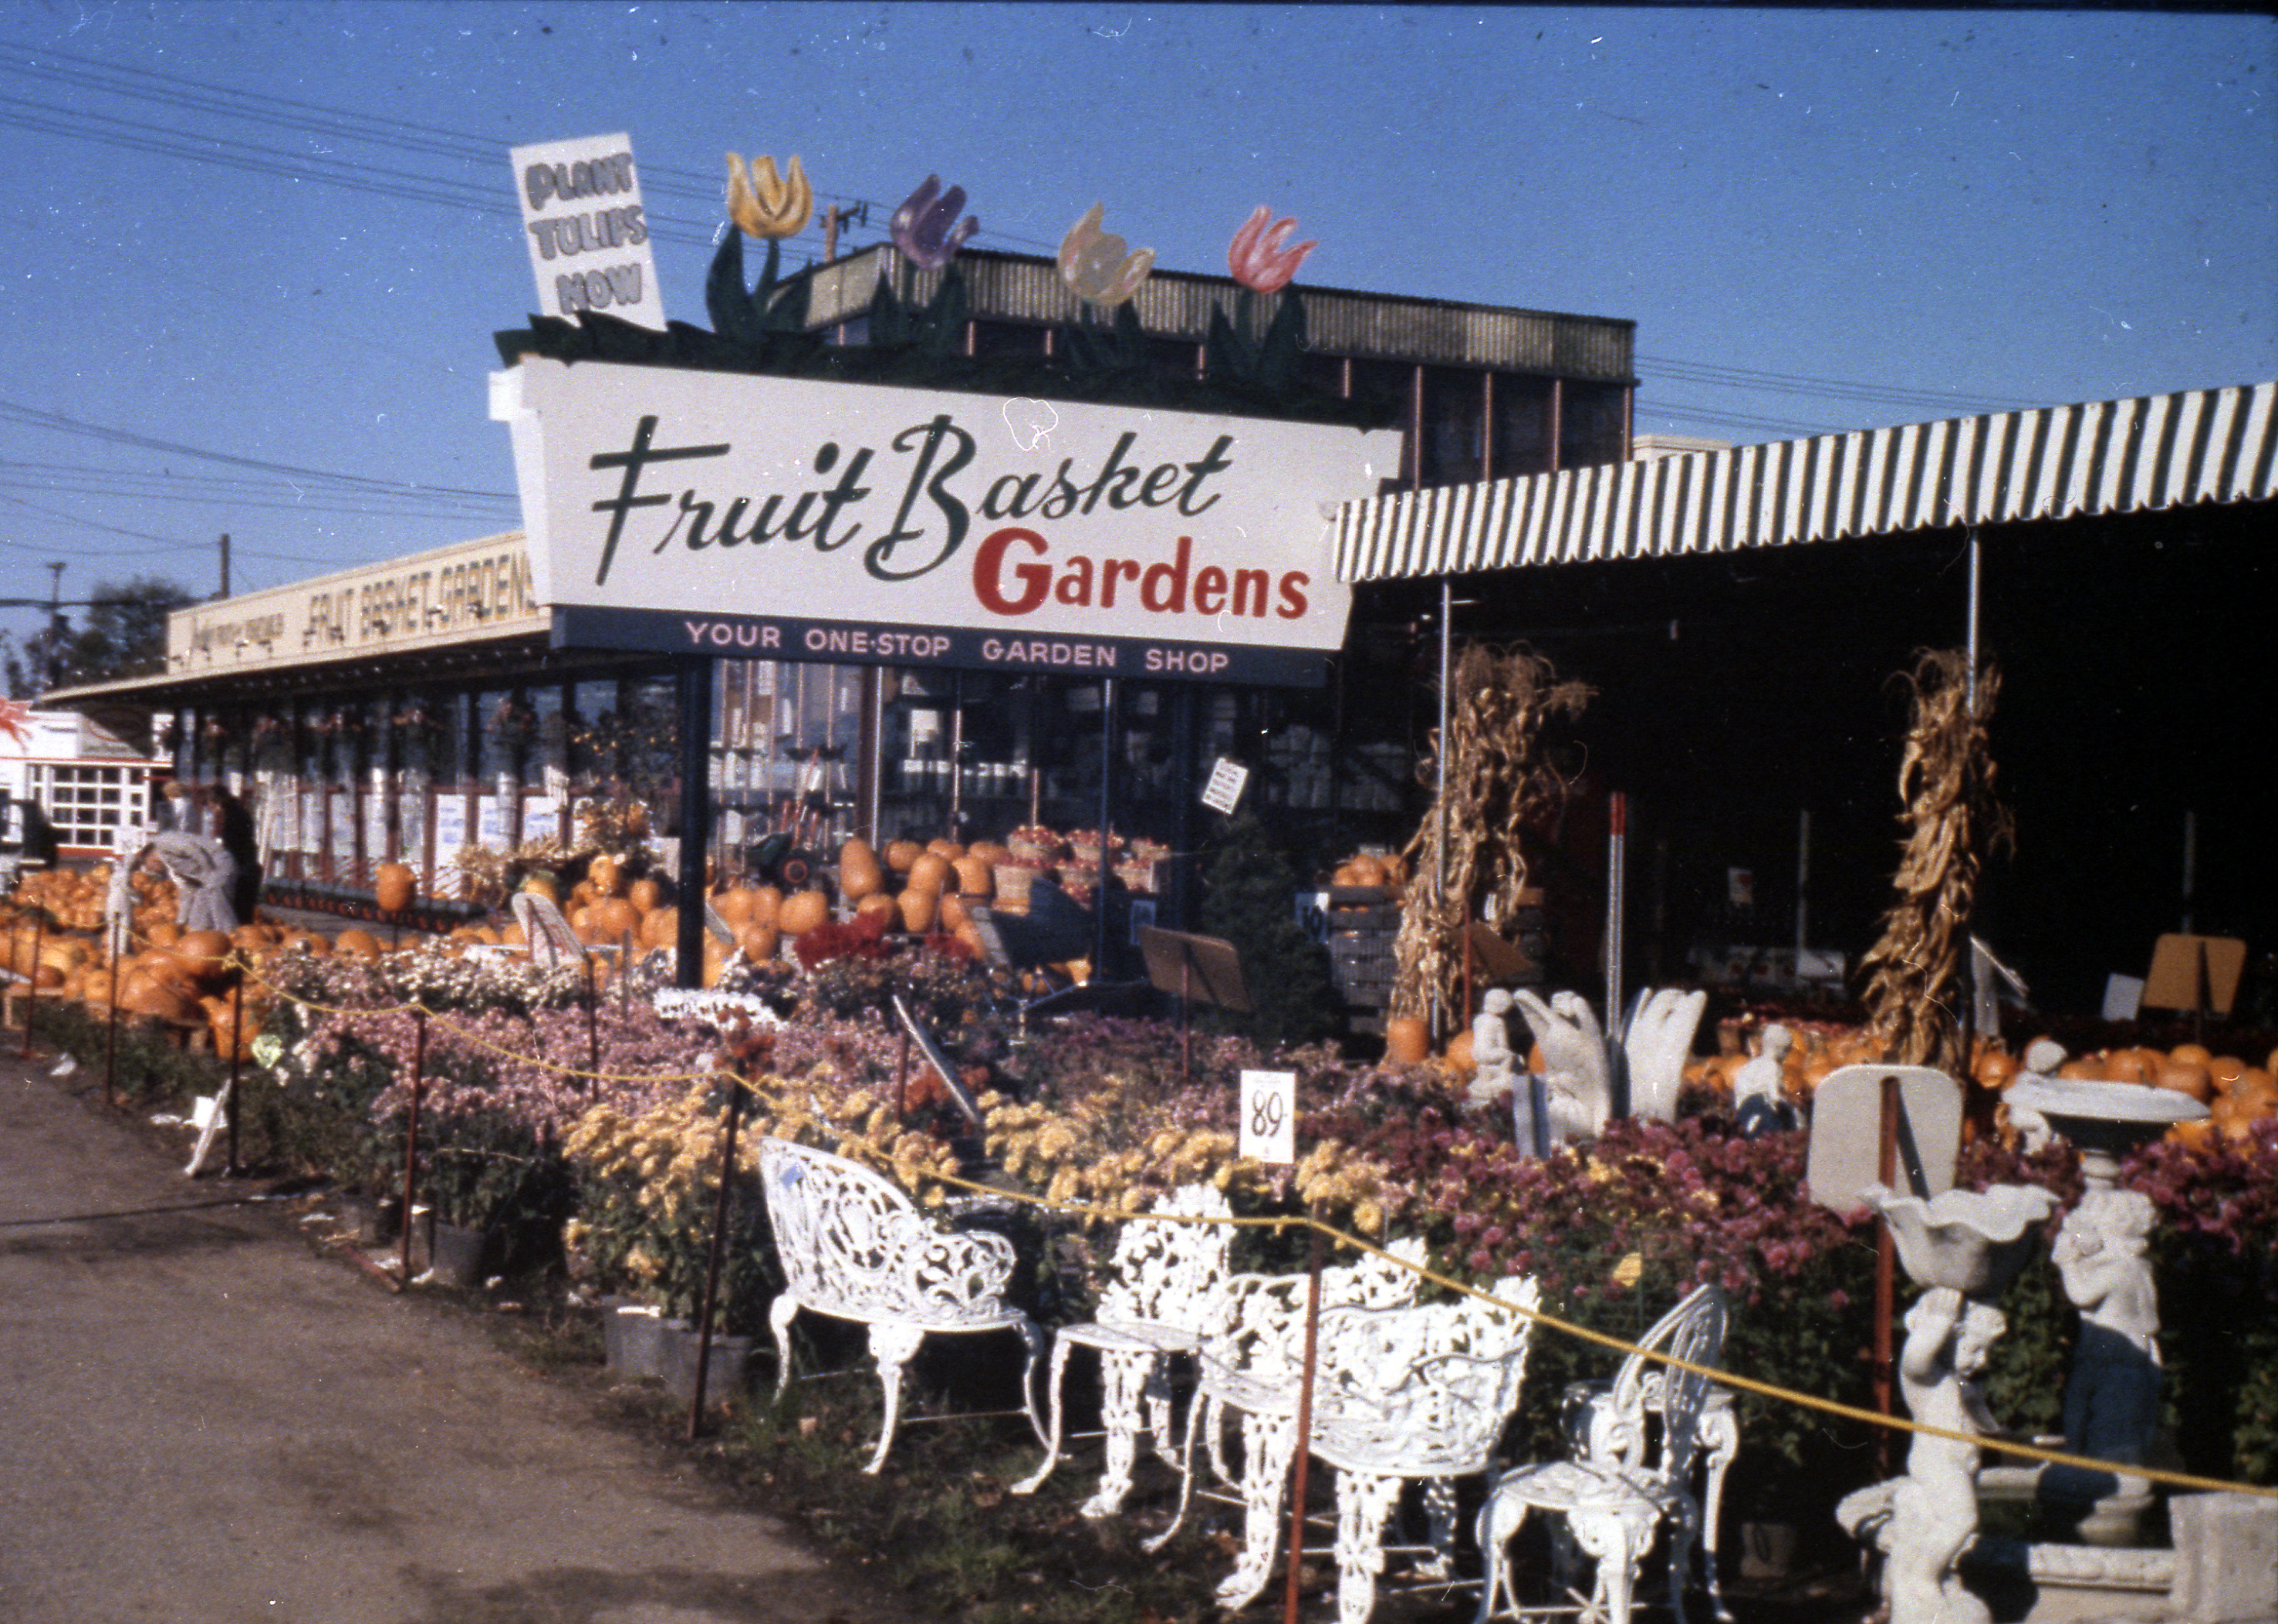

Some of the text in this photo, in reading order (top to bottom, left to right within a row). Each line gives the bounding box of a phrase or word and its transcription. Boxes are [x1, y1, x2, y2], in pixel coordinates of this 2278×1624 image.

[525, 152, 633, 211] PLANT
[528, 204, 648, 260] TULIPS
[556, 262, 643, 315] NOW
[590, 414, 1233, 586] Fruit Basket
[973, 527, 1310, 620] Gardens
[684, 621, 781, 648] YOUR
[982, 638, 1117, 667] GARDEN
[1145, 648, 1229, 674] SHOP
[1251, 1089, 1284, 1138] 89
